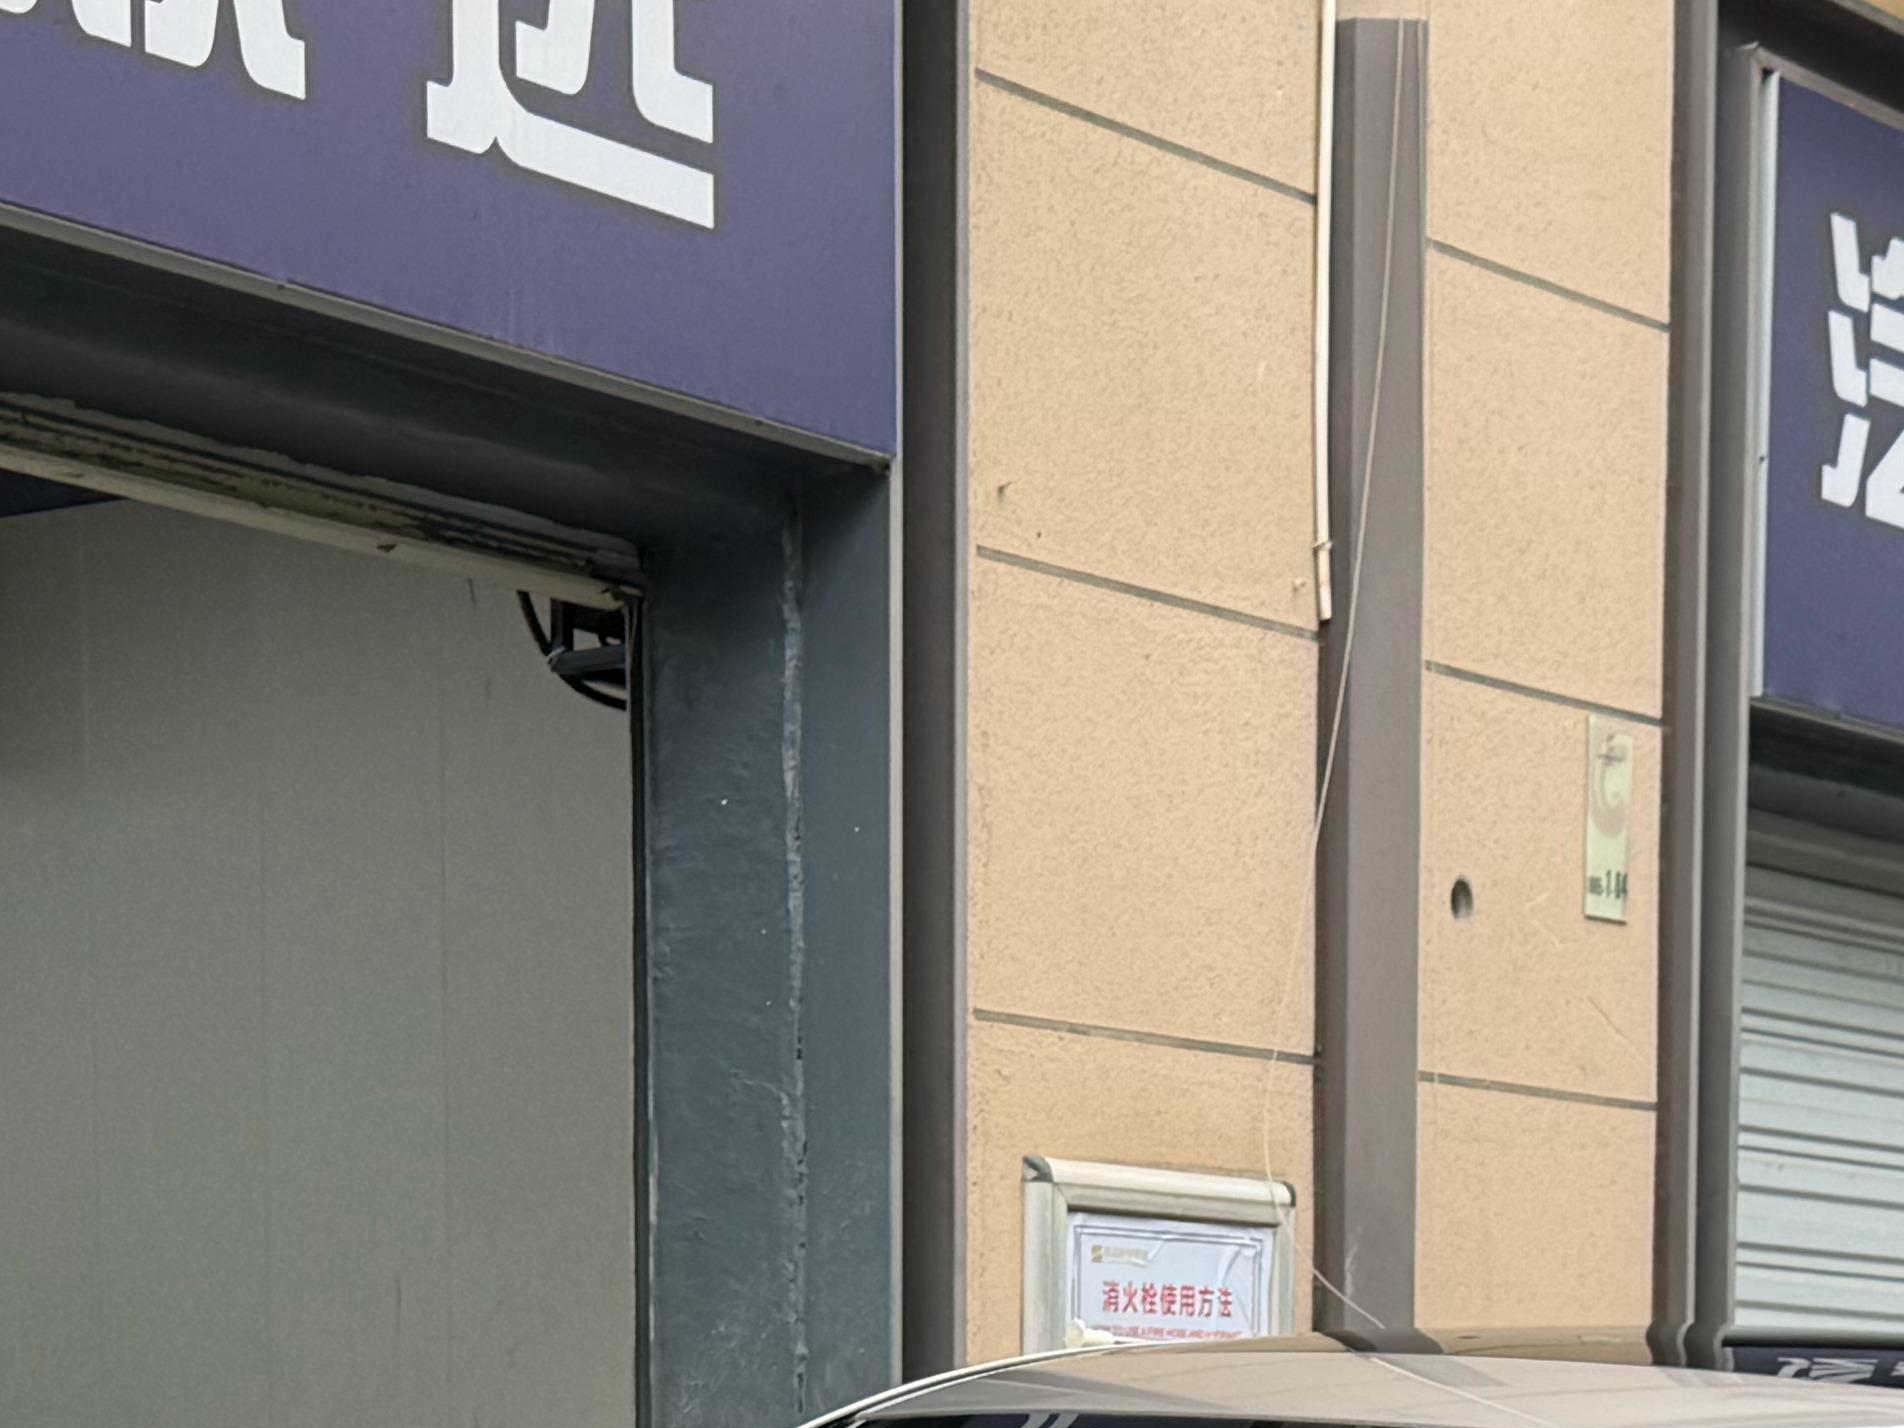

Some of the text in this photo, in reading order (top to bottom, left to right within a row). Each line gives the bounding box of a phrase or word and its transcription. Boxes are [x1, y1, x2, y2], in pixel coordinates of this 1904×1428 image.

[1101, 1279, 1233, 1319] 消火栓使用方法
